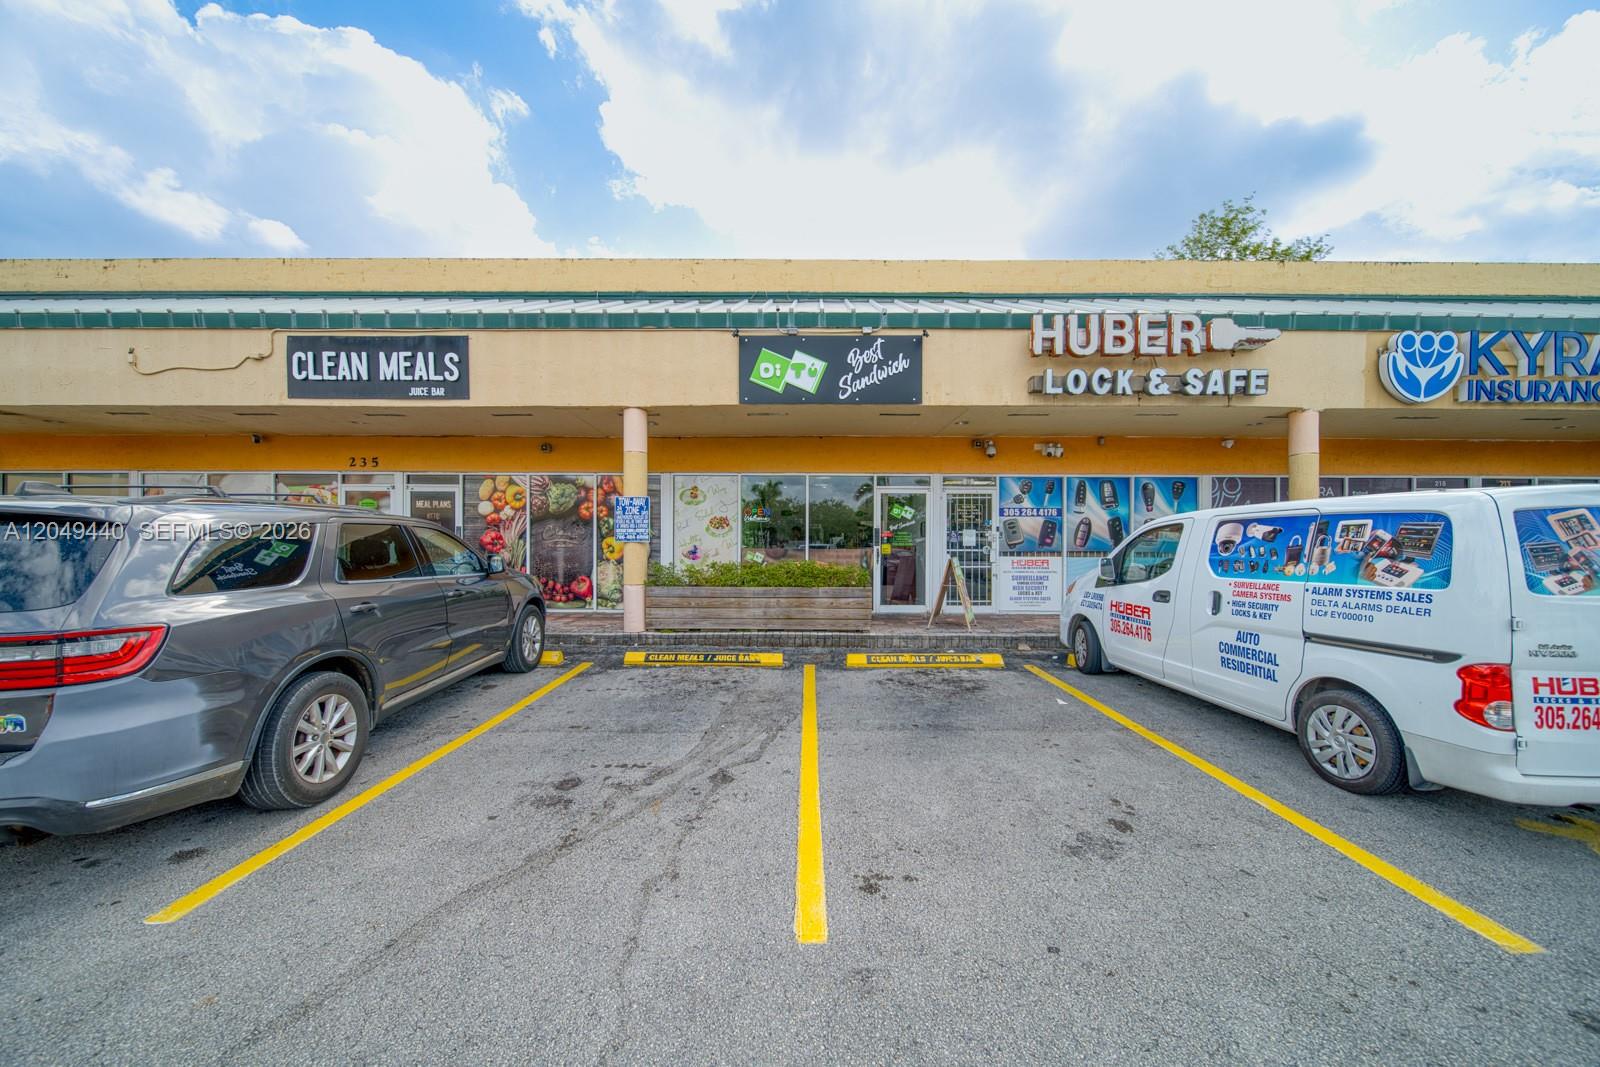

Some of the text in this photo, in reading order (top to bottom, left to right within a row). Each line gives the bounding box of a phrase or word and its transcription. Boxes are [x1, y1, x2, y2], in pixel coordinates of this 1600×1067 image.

[1031, 314, 1203, 356] HUBER
[847, 338, 885, 374] Best
[292, 351, 460, 382] CLEAN MEALS
[838, 353, 910, 400] Sandwich
[1043, 368, 1268, 395] LOCK & SAFE
[409, 387, 445, 397] JUICE BAR
[349, 457, 379, 468] 235
[1319, 486, 1335, 496] RA
[415, 500, 452, 508] MEAL PLANS
[625, 506, 641, 515] ZONE
[743, 505, 771, 516] OPEN
[1233, 581, 1280, 591] SURVEILLANCE
[1232, 590, 1292, 602] CAMERA SYSTEMS
[1312, 587, 1433, 604] ALARM SYSTEMS SALES
[1110, 600, 1151, 619] HUBER
[1231, 600, 1279, 612] HIGH SECURITY
[1311, 599, 1432, 617] DELTA ALARMS DEALER
[1231, 609, 1272, 620] LOCKS & KEY
[1310, 609, 1374, 623] LIC# EY000010
[1110, 618, 1152, 641] 305.264.4176
[1236, 630, 1260, 646] AUTO
[649, 653, 675, 661] CLEAN
[677, 653, 704, 661] MEALS
[713, 653, 736, 661] JUICE
[1219, 641, 1279, 667] COMMERCIAL
[1220, 656, 1278, 683] RESIDENTIAL
[1532, 677, 1600, 696] HUB
[1534, 705, 1600, 730] 305.264
